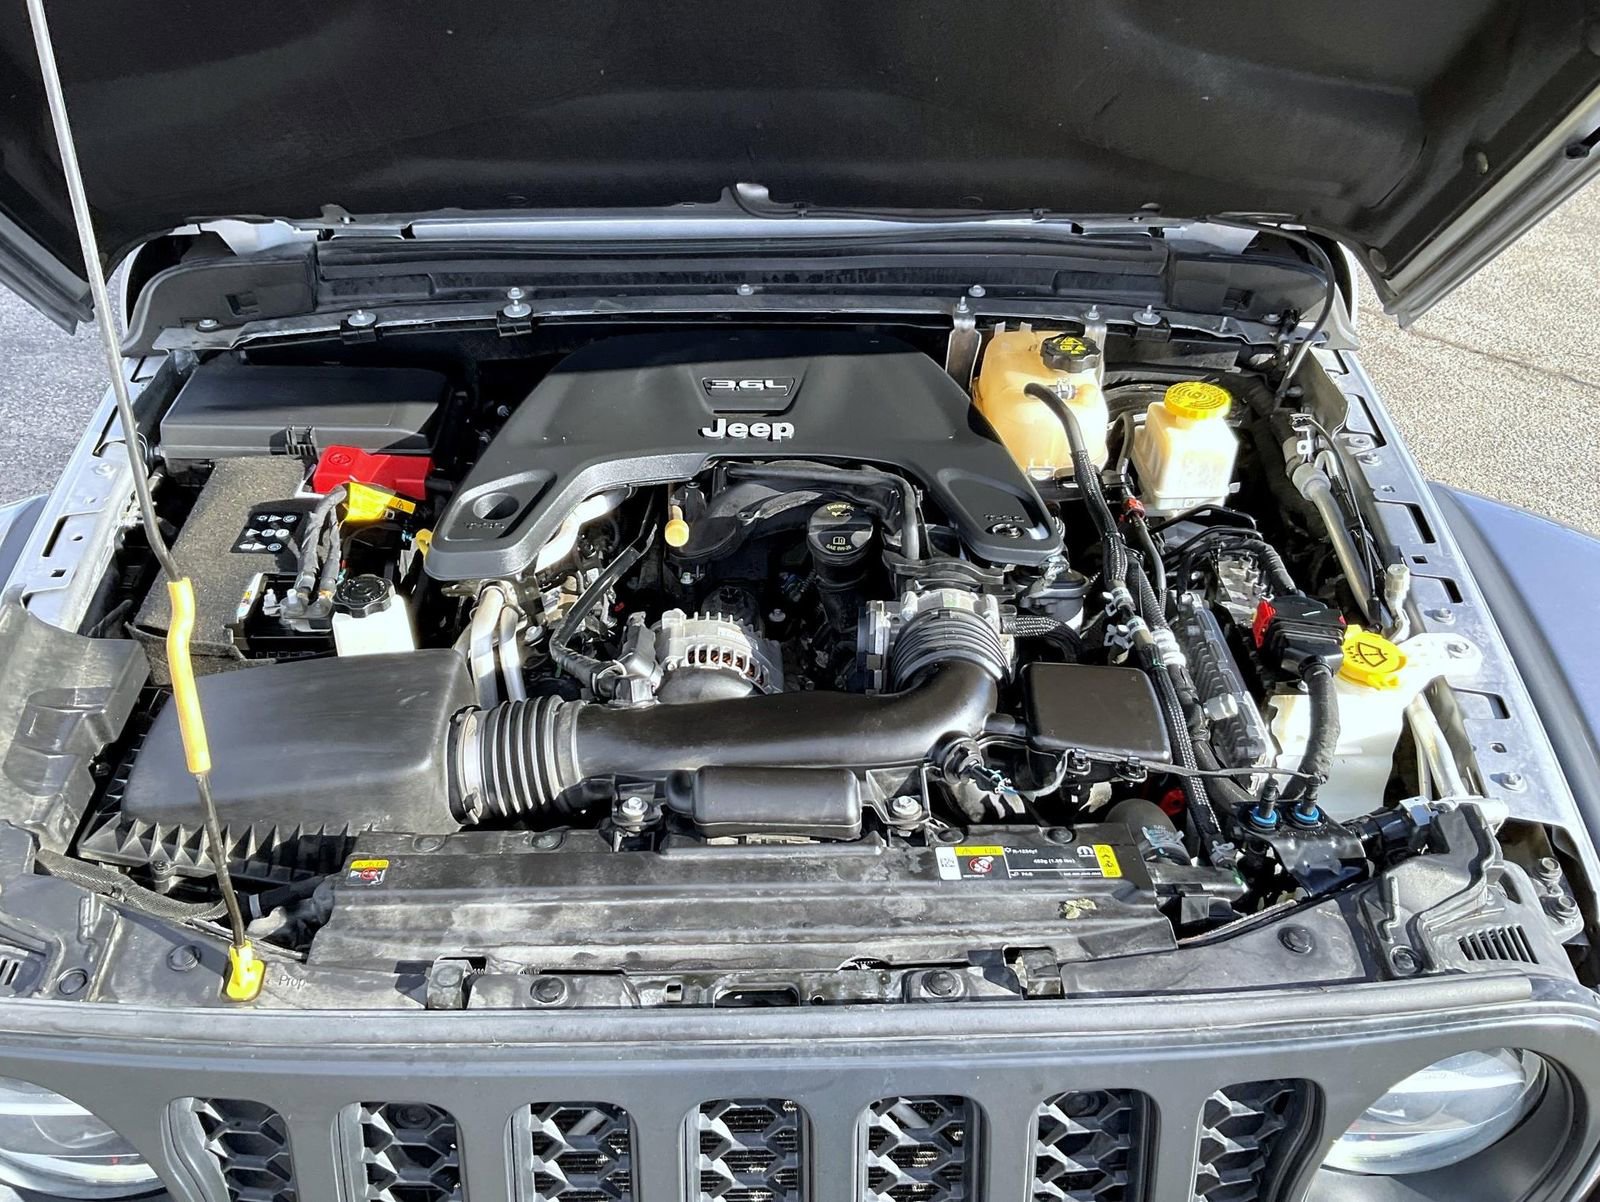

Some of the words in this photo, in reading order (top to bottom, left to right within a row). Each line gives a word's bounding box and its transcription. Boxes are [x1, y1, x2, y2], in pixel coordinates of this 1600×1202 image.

[707, 379, 788, 391] 3.6L
[700, 418, 795, 442] Jeep
[278, 975, 306, 990] Prop
